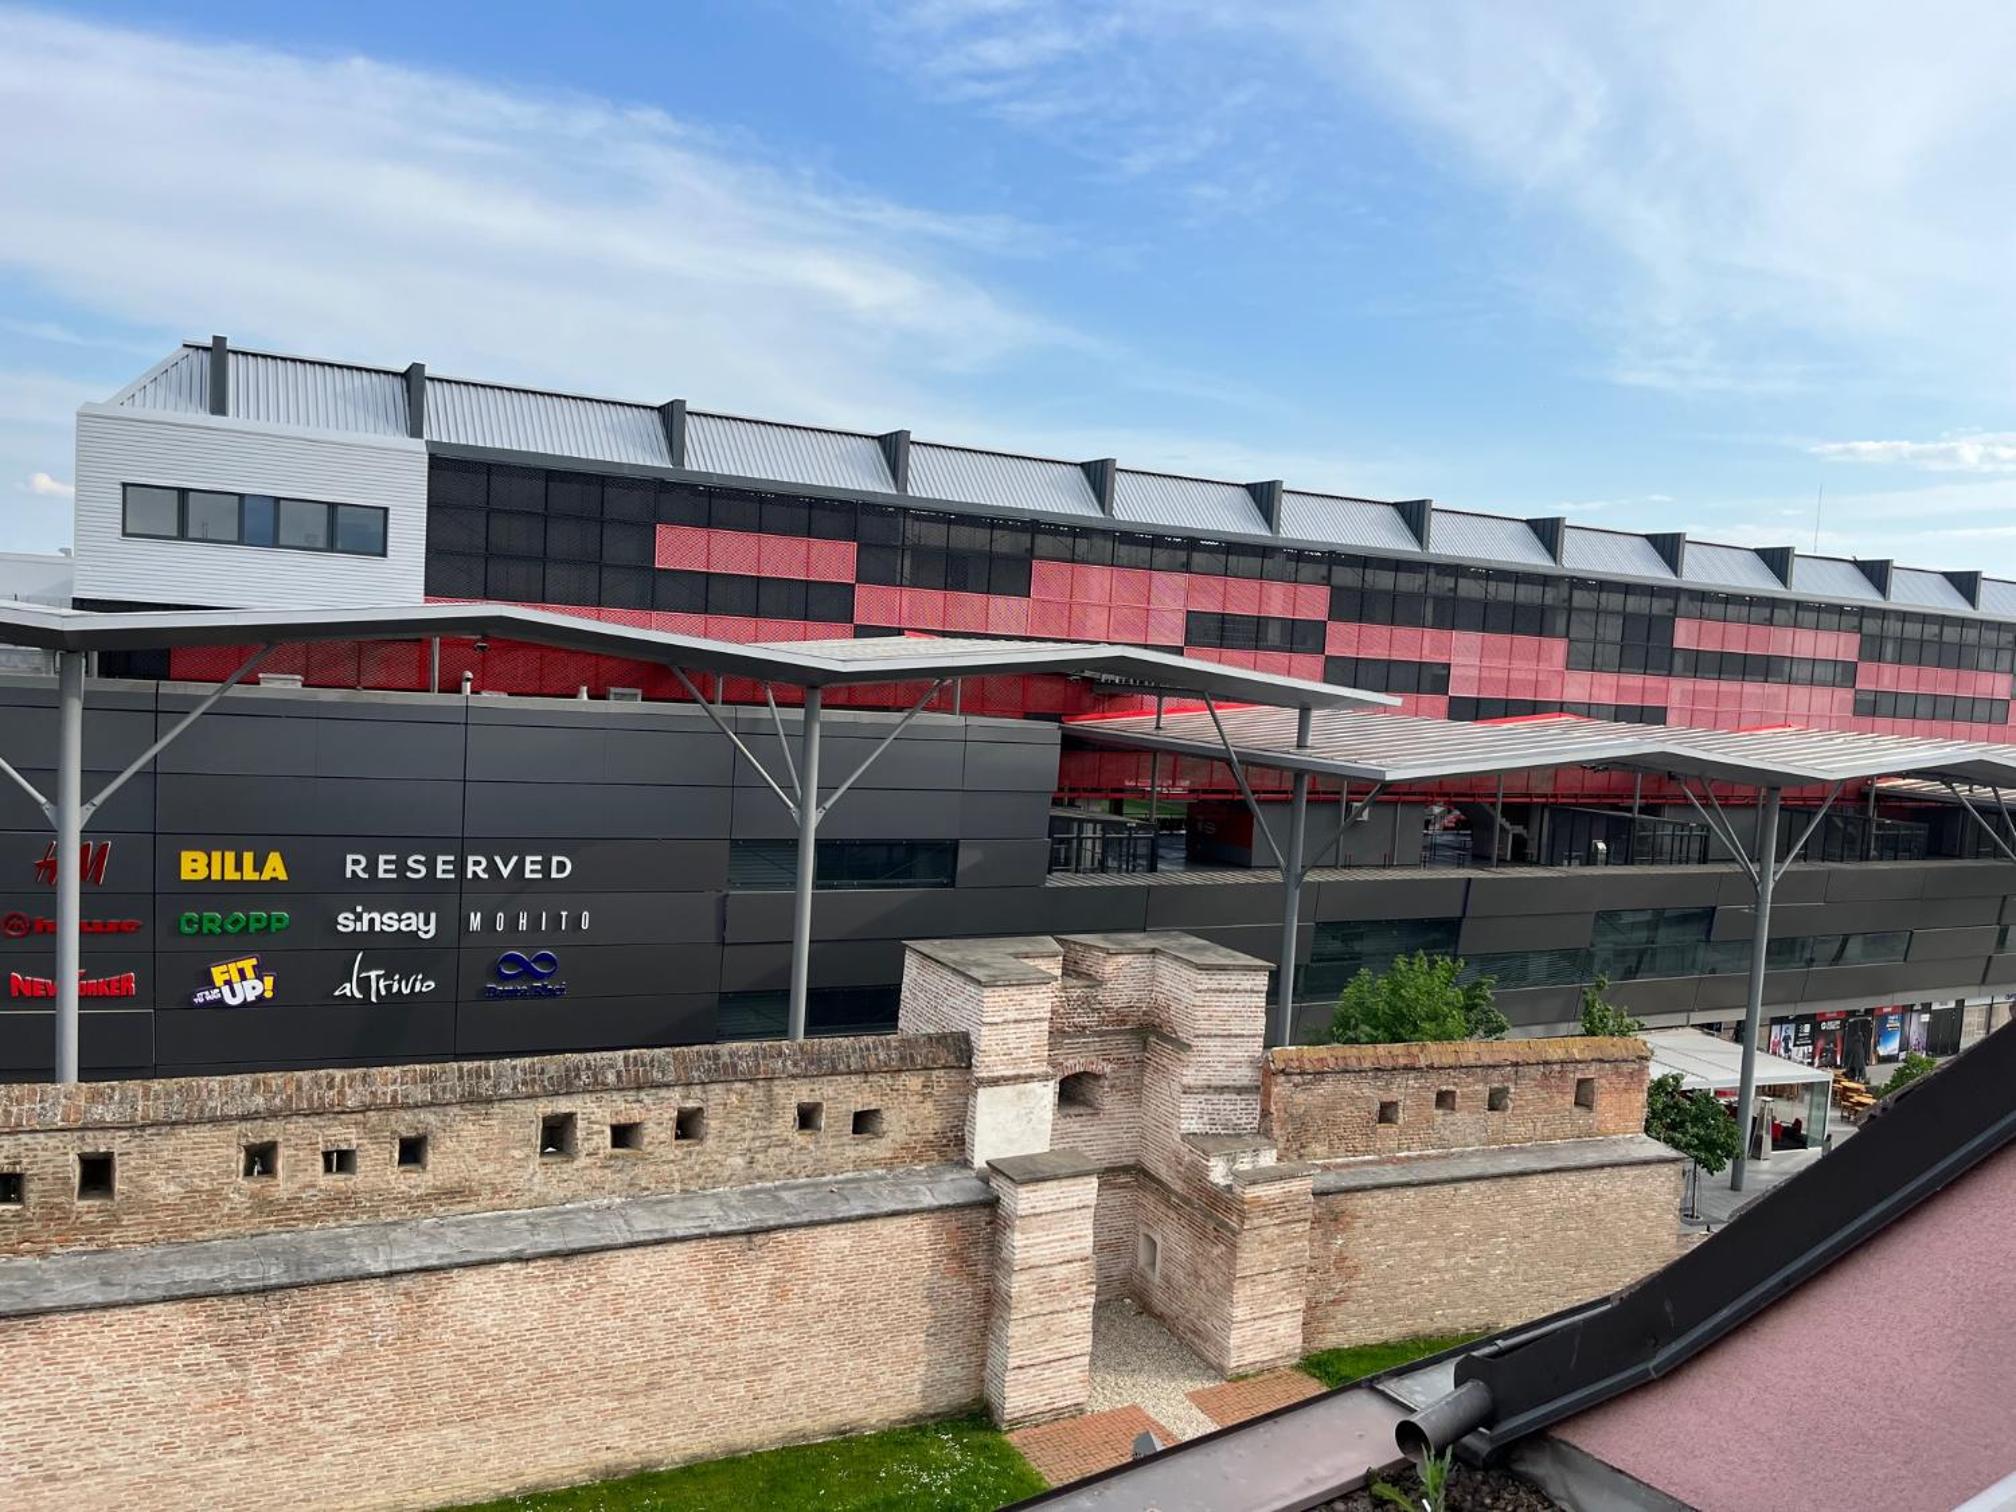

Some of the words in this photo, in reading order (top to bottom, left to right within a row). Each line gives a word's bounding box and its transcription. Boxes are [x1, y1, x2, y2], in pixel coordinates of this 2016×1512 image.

[35, 840, 112, 887] HM
[180, 850, 289, 881] BILLA
[345, 854, 573, 879] RESERVED
[179, 912, 290, 935] CROPP
[336, 905, 437, 939] sinsay
[469, 911, 590, 932] MOHITO
[211, 957, 258, 988] FIT
